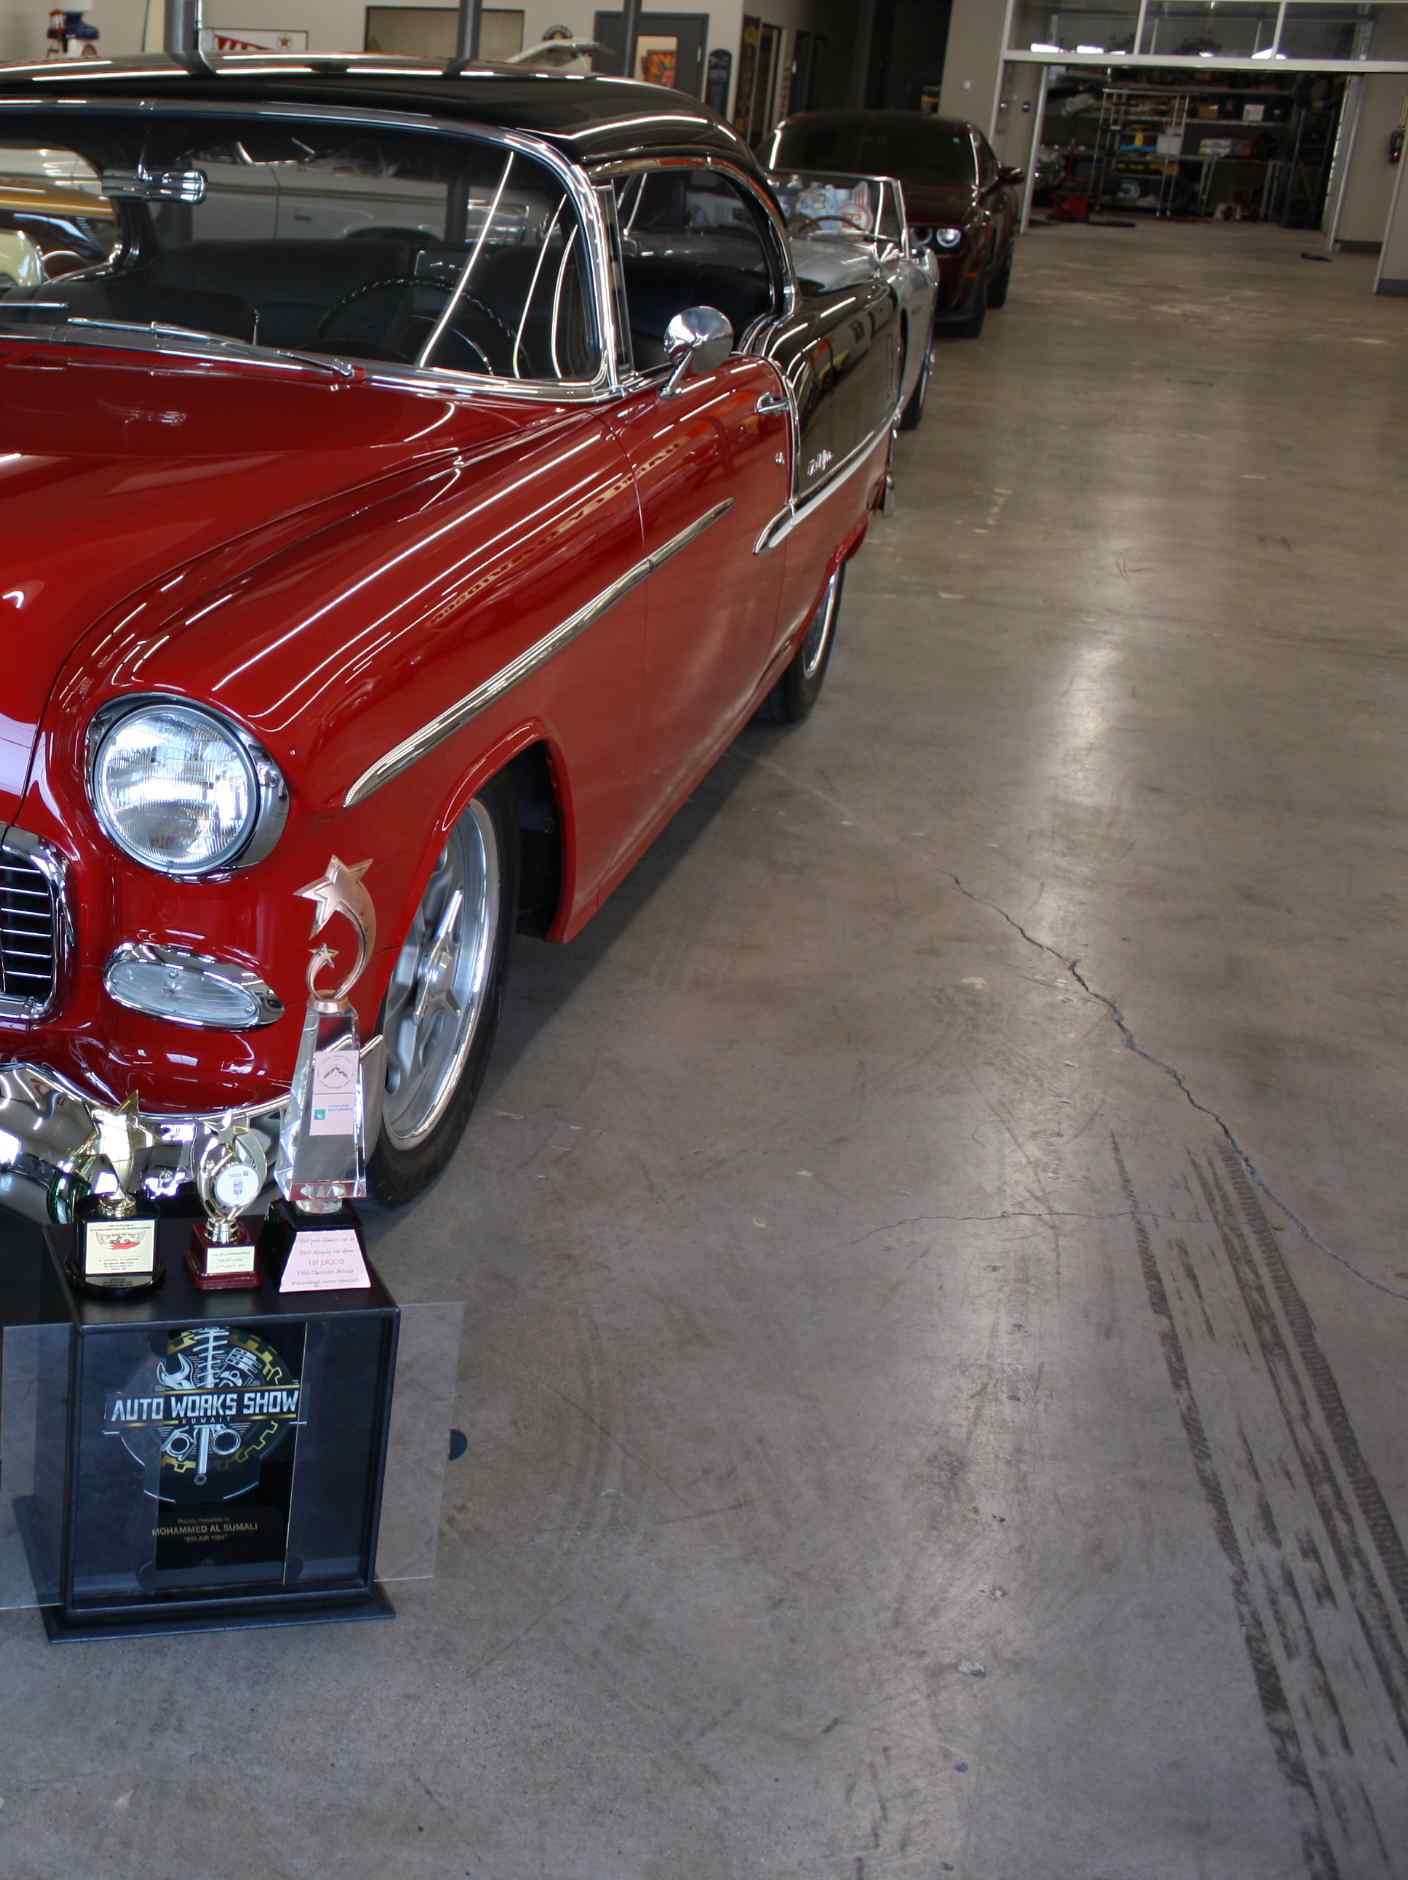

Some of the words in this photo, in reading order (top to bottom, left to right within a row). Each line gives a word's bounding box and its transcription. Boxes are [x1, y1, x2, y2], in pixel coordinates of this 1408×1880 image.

[111, 1397, 164, 1422] AUTO
[171, 1393, 237, 1418] WORKS
[243, 1390, 299, 1415] SHOW
